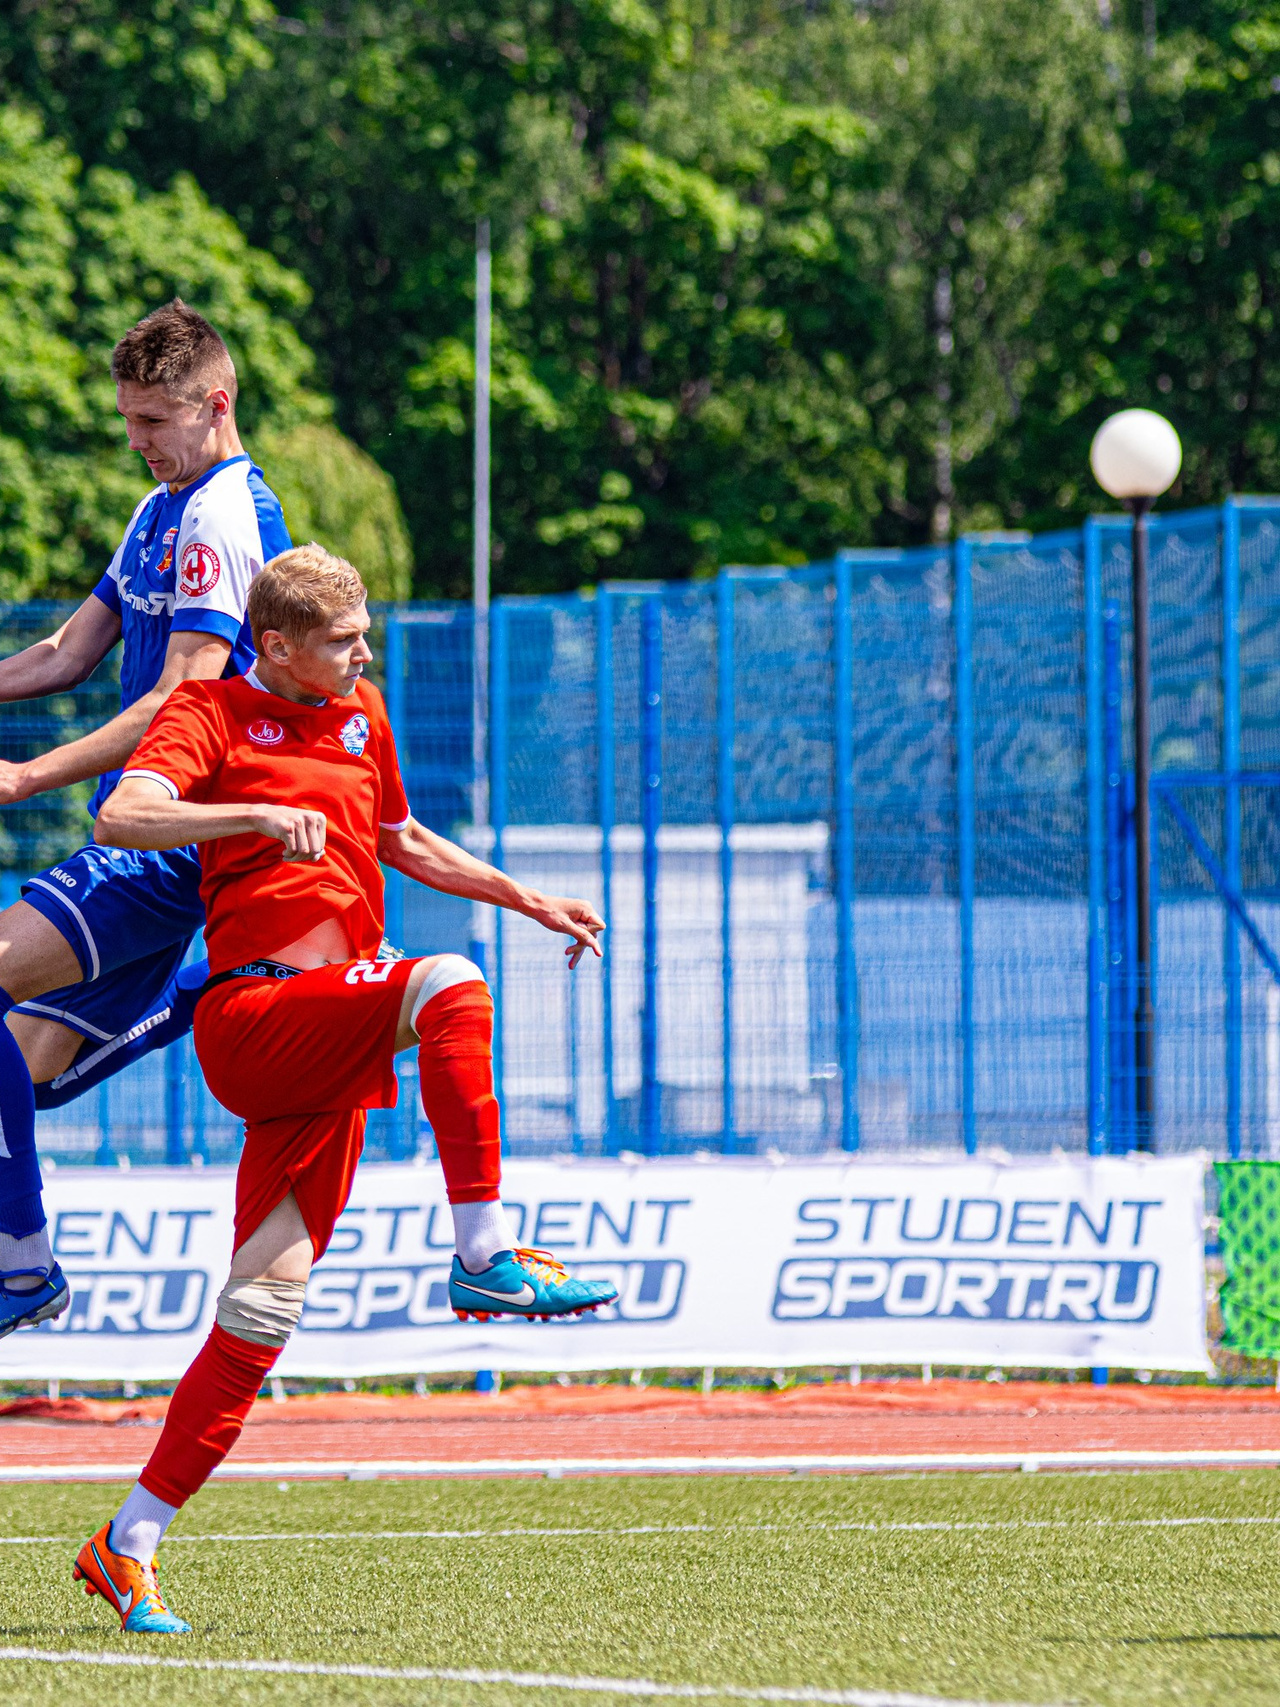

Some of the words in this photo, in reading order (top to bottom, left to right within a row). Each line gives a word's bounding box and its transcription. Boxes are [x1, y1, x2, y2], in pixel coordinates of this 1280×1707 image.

[50, 867, 77, 888] JAKO
[794, 1197, 1164, 1247] STUDENT
[773, 1259, 1157, 1323] SPORT.RU
